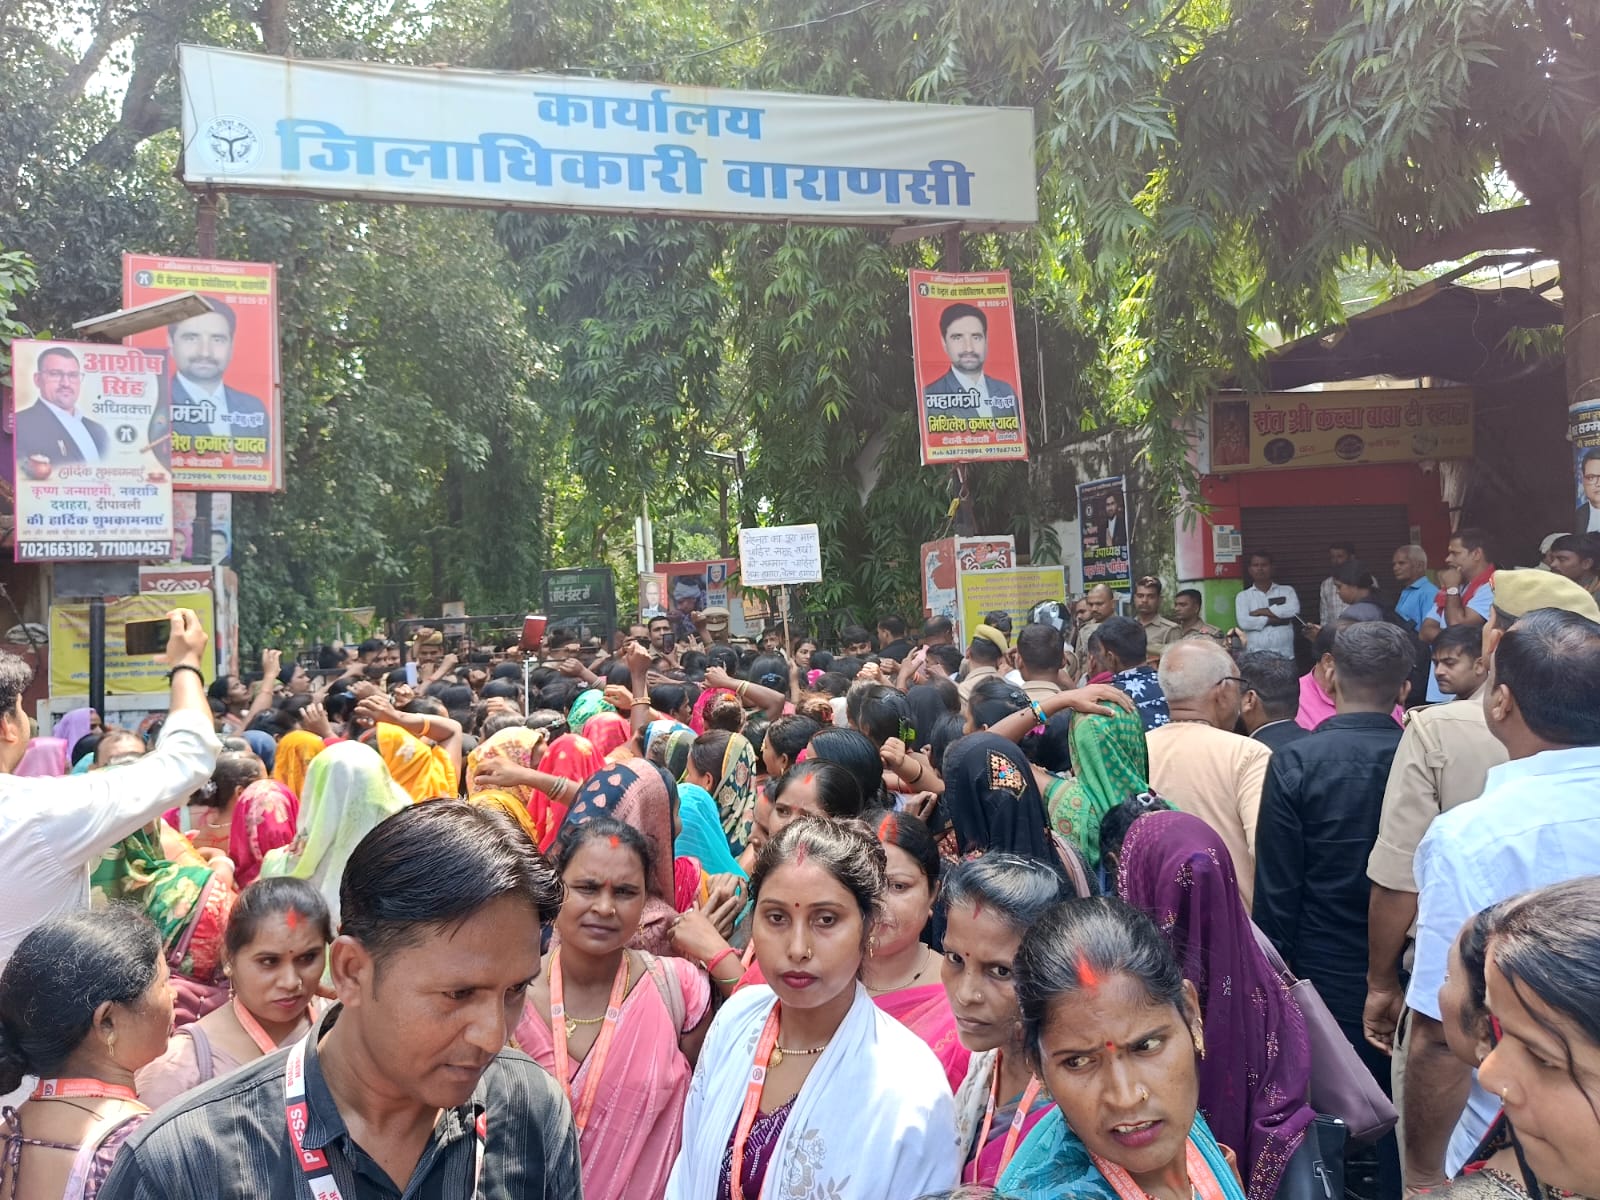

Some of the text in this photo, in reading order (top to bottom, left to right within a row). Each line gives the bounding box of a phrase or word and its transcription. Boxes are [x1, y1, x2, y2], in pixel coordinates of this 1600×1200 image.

[534, 89, 766, 140] कार्यालय
[275, 118, 975, 206] जिलाधिकारी वाराणसी
[84, 350, 164, 375] आशीष
[102, 375, 145, 396] सिंह
[92, 399, 152, 416] अधिवक्ता
[925, 387, 980, 409] महामंत्री
[171, 399, 216, 423] मंत्री
[1254, 404, 1285, 435] संत
[1288, 403, 1312, 433] श्री
[1315, 406, 1364, 431] कच्चा
[1367, 405, 1401, 428] बाबा
[1404, 399, 1423, 427] टी
[928, 414, 1018, 434] मिथिलेश कुमार यादव
[194, 436, 232, 455] कुमार
[234, 437, 267, 453] यादव
[32, 485, 59, 499] कृष्ण
[120, 484, 159, 497] नवरात्रि
[51, 497, 141, 511] दशहरा, दीपावली
[27, 513, 44, 526] की
[49, 513, 88, 526] हार्दिक
[20, 541, 171, 558] 7021663182, 7710044257
